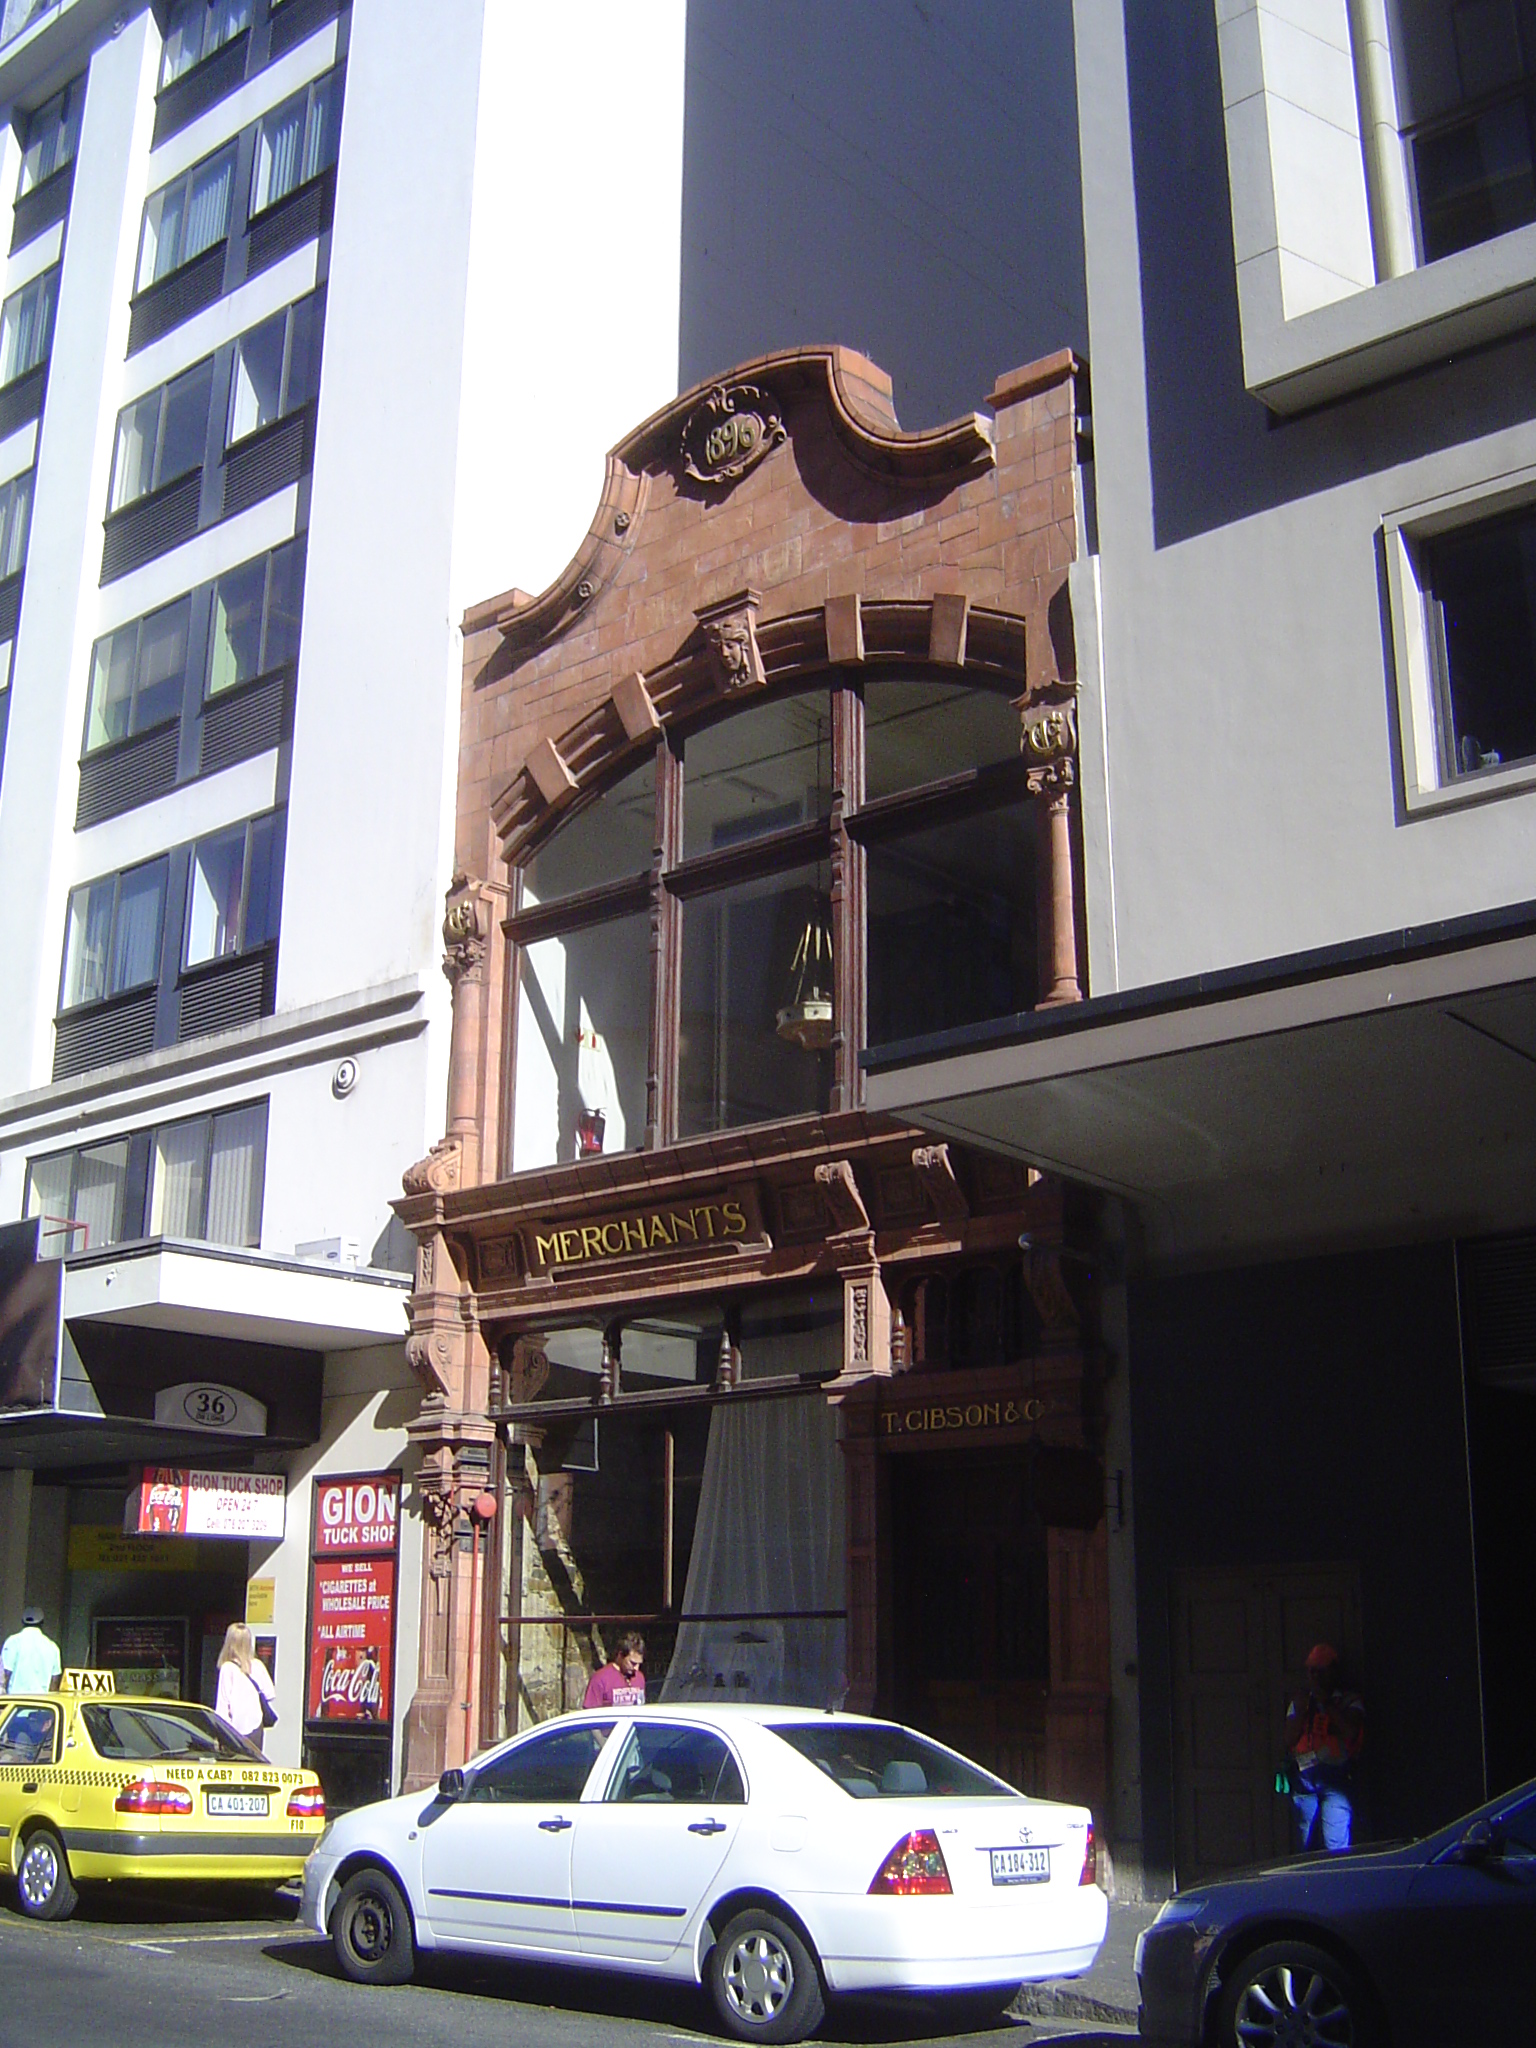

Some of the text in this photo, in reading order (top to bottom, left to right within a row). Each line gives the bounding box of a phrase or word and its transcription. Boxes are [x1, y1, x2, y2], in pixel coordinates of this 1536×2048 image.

[706, 415, 756, 465] 1896
[535, 1202, 747, 1265] MERCHANTS
[197, 1393, 225, 1414] 36
[905, 1402, 1001, 1431] GIBSON
[191, 1473, 283, 1496] GION TUCK SHOP
[216, 1497, 239, 1511] OPEN
[322, 1485, 396, 1525] GION
[323, 1527, 359, 1545] TUCK
[341, 1562, 373, 1573] WE SELL
[368, 1579, 376, 1592] at
[322, 1595, 390, 1612] WHOLESALE PRICE
[335, 1624, 366, 1638] AIRTIME
[69, 1672, 113, 1692] TAXI
[166, 1769, 304, 1785] NEED A CAB? 082 823 0073
[211, 1797, 266, 1811] CA 401-207
[993, 1851, 1046, 1874] CA 184-312
